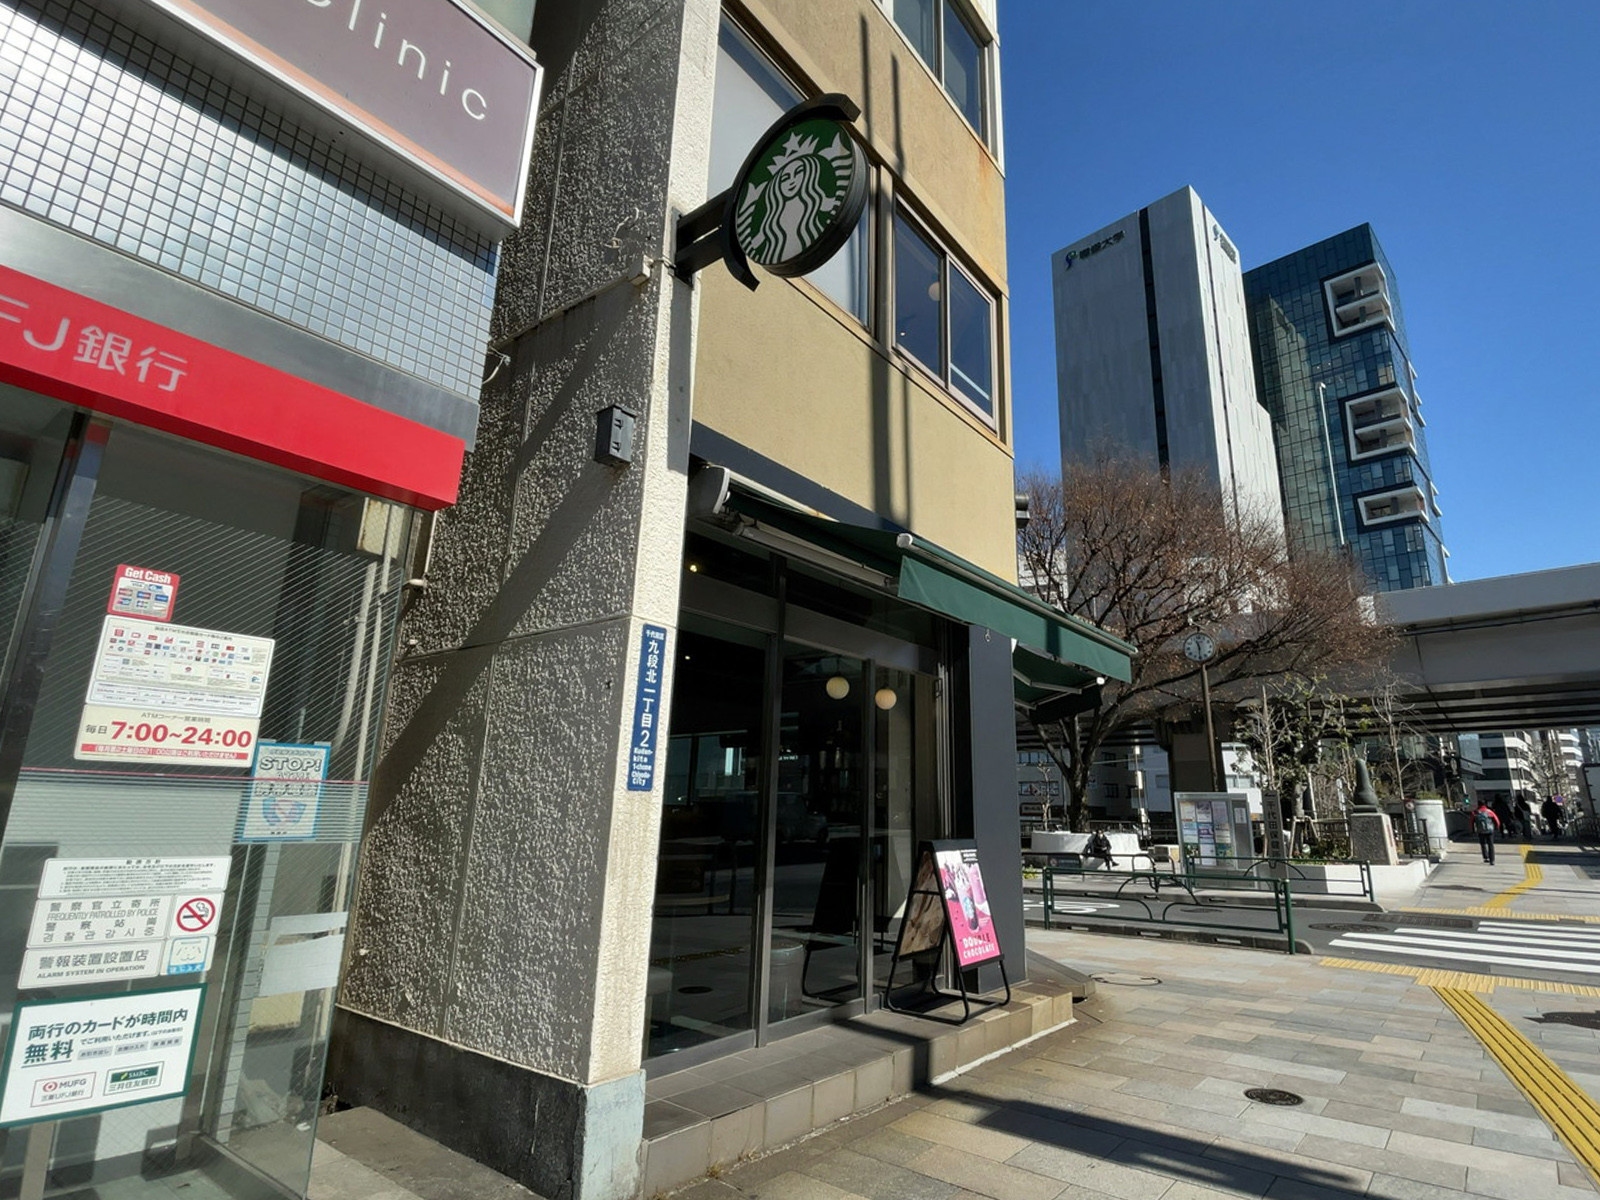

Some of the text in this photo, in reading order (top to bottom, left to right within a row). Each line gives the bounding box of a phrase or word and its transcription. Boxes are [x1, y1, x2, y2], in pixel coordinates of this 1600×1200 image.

[307, 0, 487, 120] linic
[125, 567, 171, 584] Get Cash
[86, 724, 107, 734] 毎日
[260, 756, 322, 772] STOP!
[127, 909, 135, 917] BY
[136, 908, 158, 916] POLICE
[39, 950, 148, 970] 警報装置設置店
[65, 969, 94, 977] SYSTEM
[106, 964, 145, 973] OPERATION
[28, 1009, 188, 1040] 両行のカードが時間内
[23, 1039, 73, 1064] 無料
[128, 1069, 149, 1079] SMBC
[59, 1078, 87, 1089] MUFG
[108, 1077, 157, 1091] 三井住友銀行
